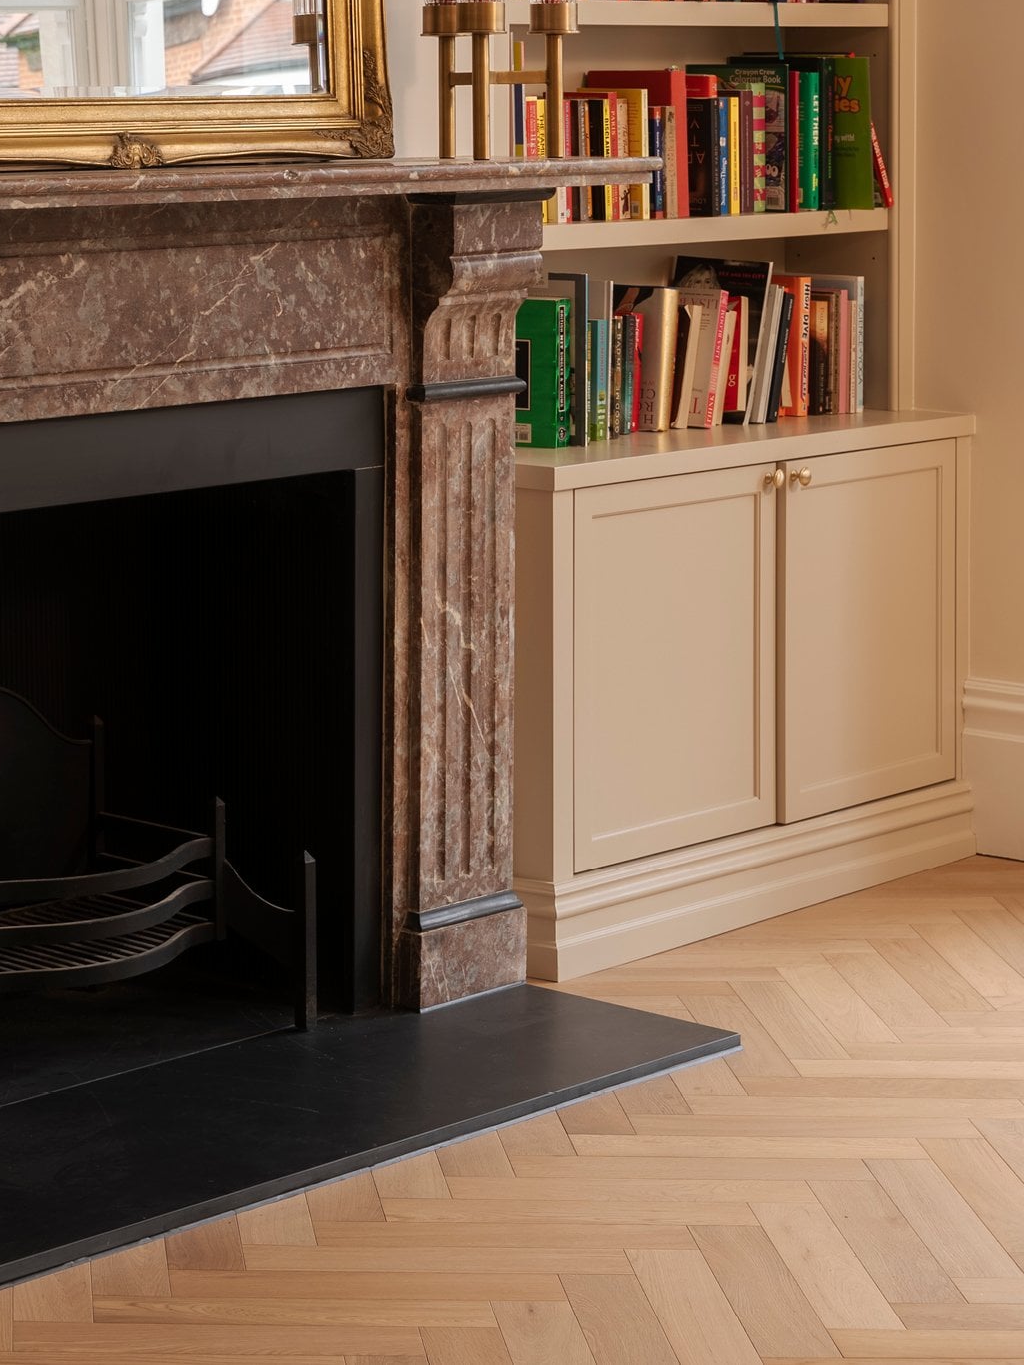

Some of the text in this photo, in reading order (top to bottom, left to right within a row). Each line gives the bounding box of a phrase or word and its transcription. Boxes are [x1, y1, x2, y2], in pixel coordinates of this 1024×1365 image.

[734, 69, 758, 77] Crayon
[762, 75, 781, 84] Book
[802, 283, 811, 340] HIGH DIVE
[707, 394, 715, 423] THINK
[718, 309, 726, 338] BLOOM
